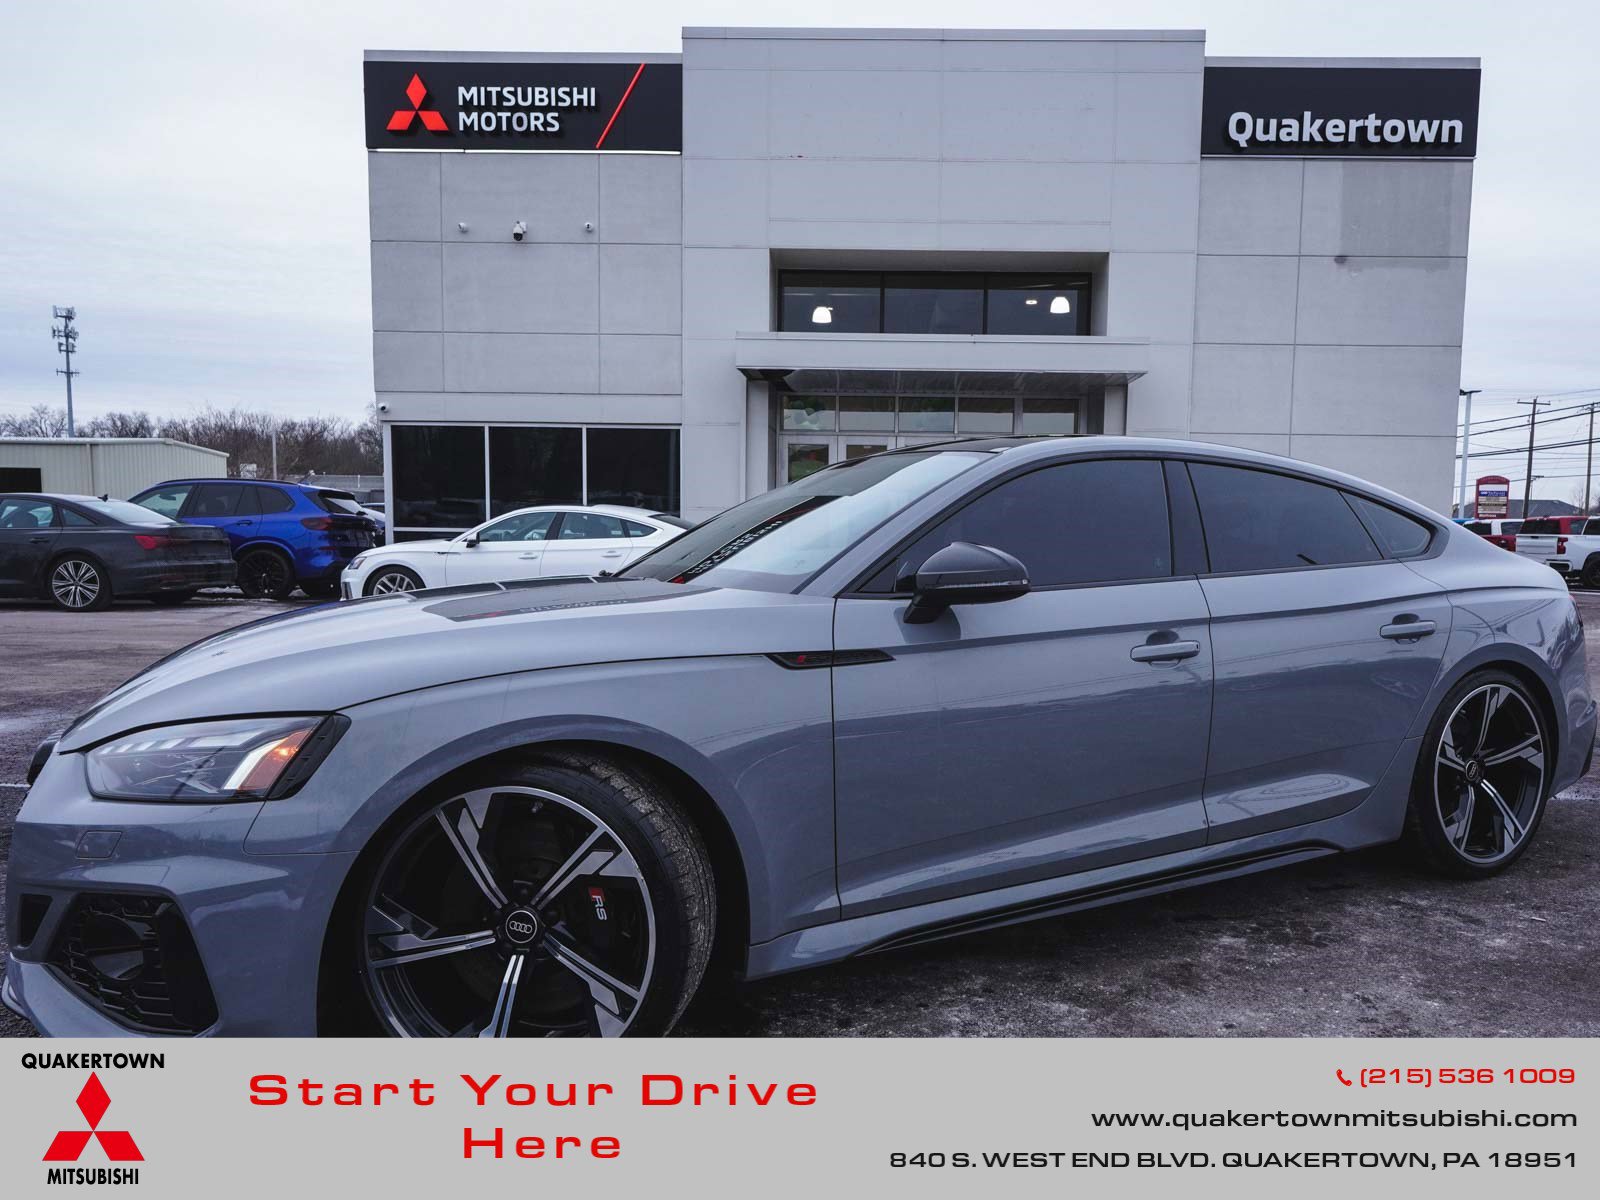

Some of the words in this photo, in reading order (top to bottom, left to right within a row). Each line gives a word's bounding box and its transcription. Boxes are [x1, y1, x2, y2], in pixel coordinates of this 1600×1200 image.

[457, 86, 596, 107] MITSUBISHI
[458, 111, 560, 132] MOTORS
[1228, 111, 1463, 148] Quakertown
[591, 893, 608, 921] RS
